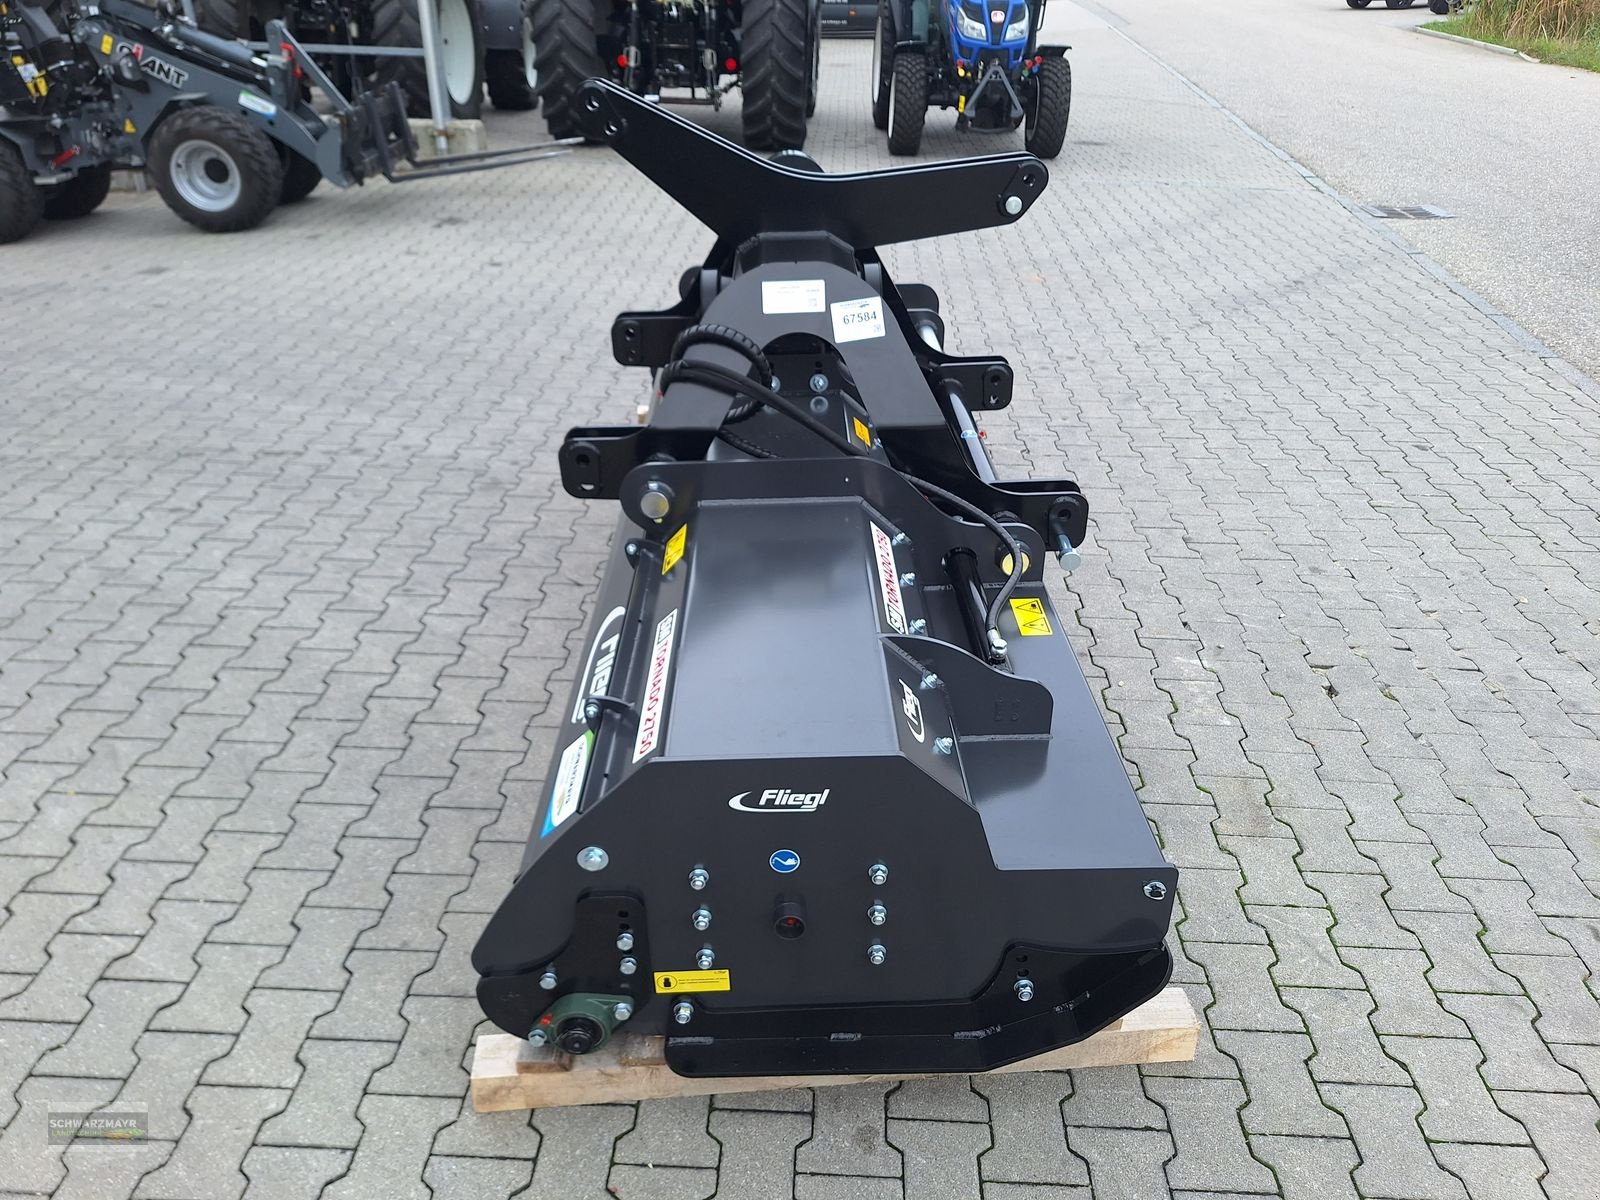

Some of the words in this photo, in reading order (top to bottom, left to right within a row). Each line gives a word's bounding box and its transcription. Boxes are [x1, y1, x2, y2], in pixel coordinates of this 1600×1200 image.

[843, 311, 877, 325] 67584
[880, 554, 900, 611] TORNADO
[648, 640, 668, 711] TORNADO
[639, 712, 657, 755] 2750
[758, 788, 831, 809] Fliegl
